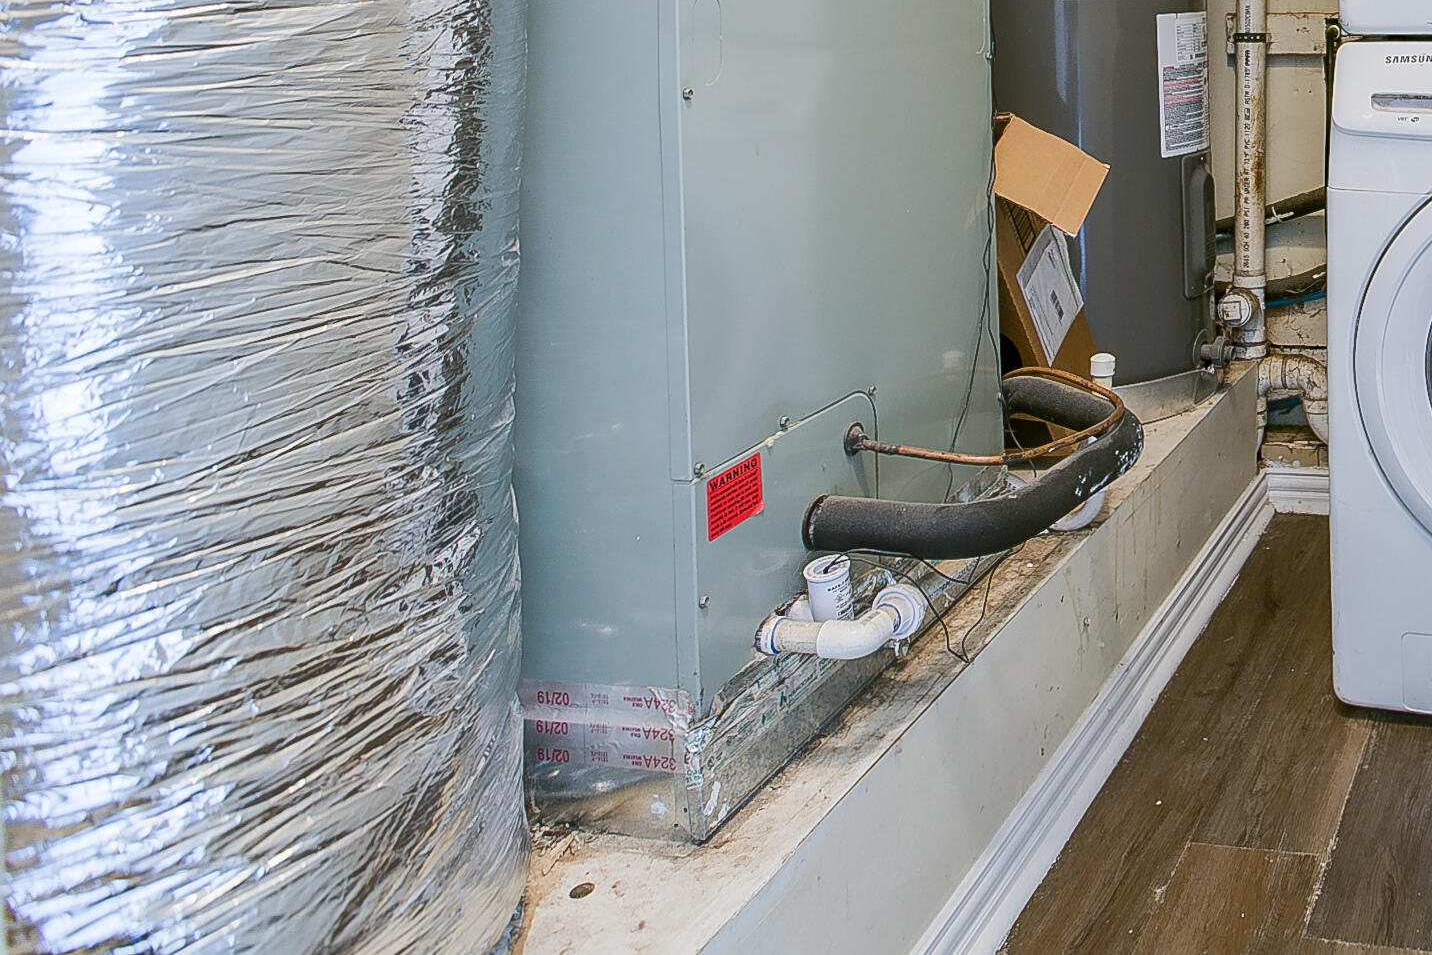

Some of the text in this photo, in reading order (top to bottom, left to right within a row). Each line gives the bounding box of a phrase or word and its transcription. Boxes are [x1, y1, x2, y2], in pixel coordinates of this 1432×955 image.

[709, 458, 757, 492] WARNING
[537, 691, 569, 706] 02/19
[536, 719, 568, 735] 02/19
[642, 727, 675, 741] 324A
[537, 748, 569, 763] 02/19
[643, 755, 676, 770] 324A
